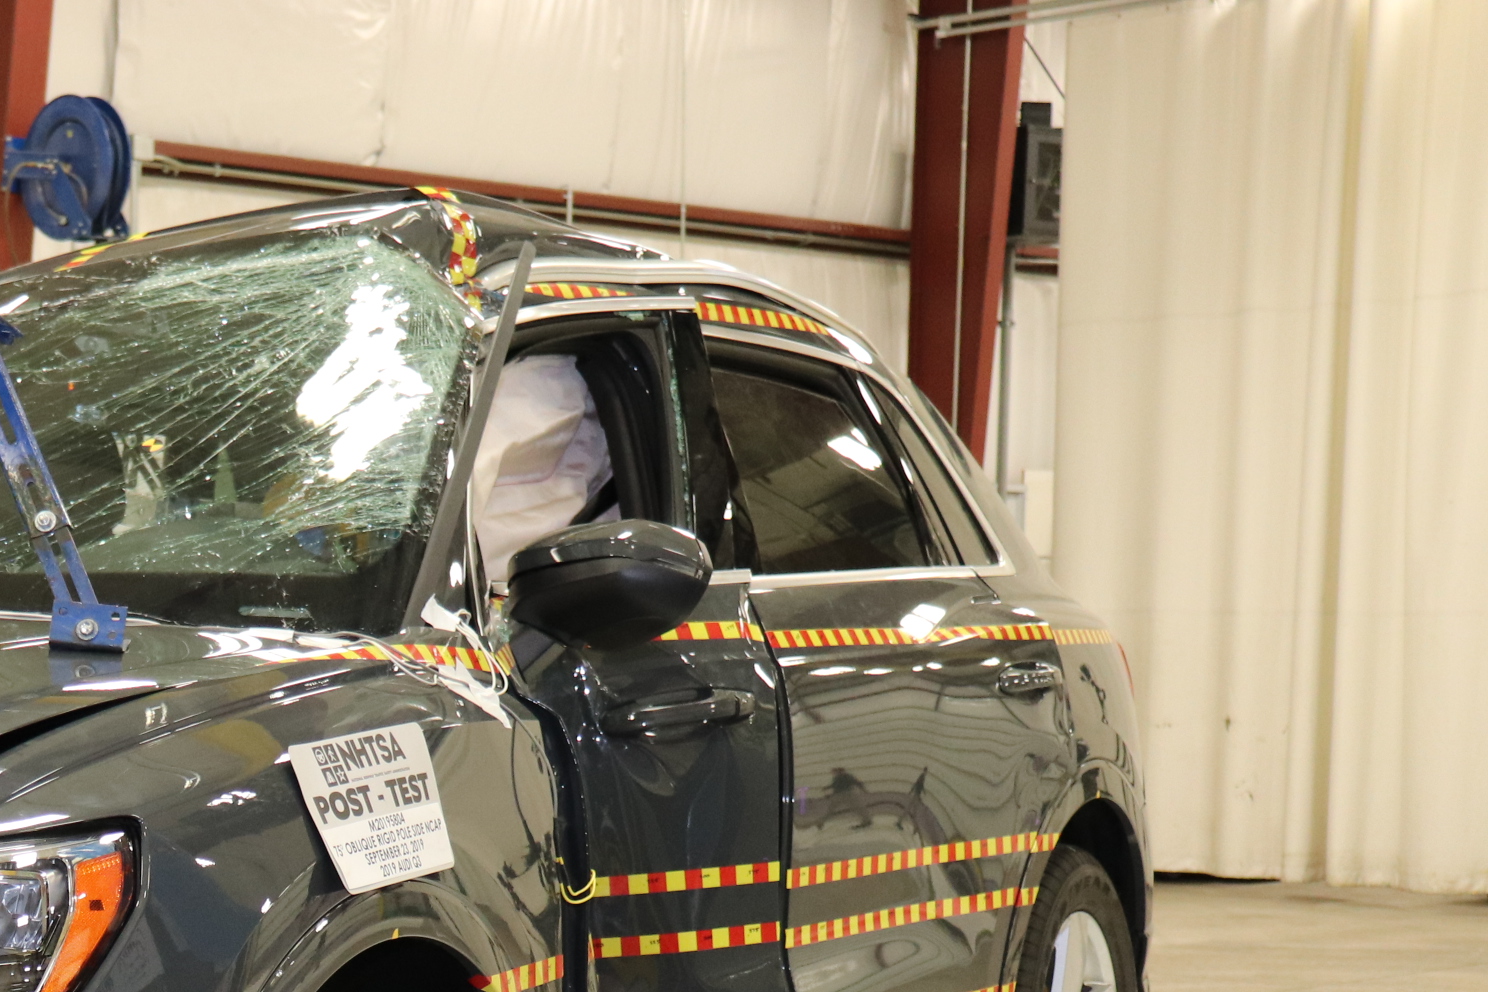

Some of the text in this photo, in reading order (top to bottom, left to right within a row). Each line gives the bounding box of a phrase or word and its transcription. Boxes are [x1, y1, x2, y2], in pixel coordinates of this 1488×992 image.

[336, 732, 406, 771] NHTSA
[313, 785, 375, 825] POST
[384, 773, 430, 807] TEST
[345, 836, 377, 855] OBLIQUE
[376, 831, 397, 847] RIGID
[396, 826, 413, 841] POLE
[412, 822, 426, 837] SIDE
[425, 818, 442, 833] NCAP
[364, 846, 400, 866] SEPTEMBER
[410, 838, 425, 853] 2019
[380, 855, 423, 877] 2019 AUDI Q3
